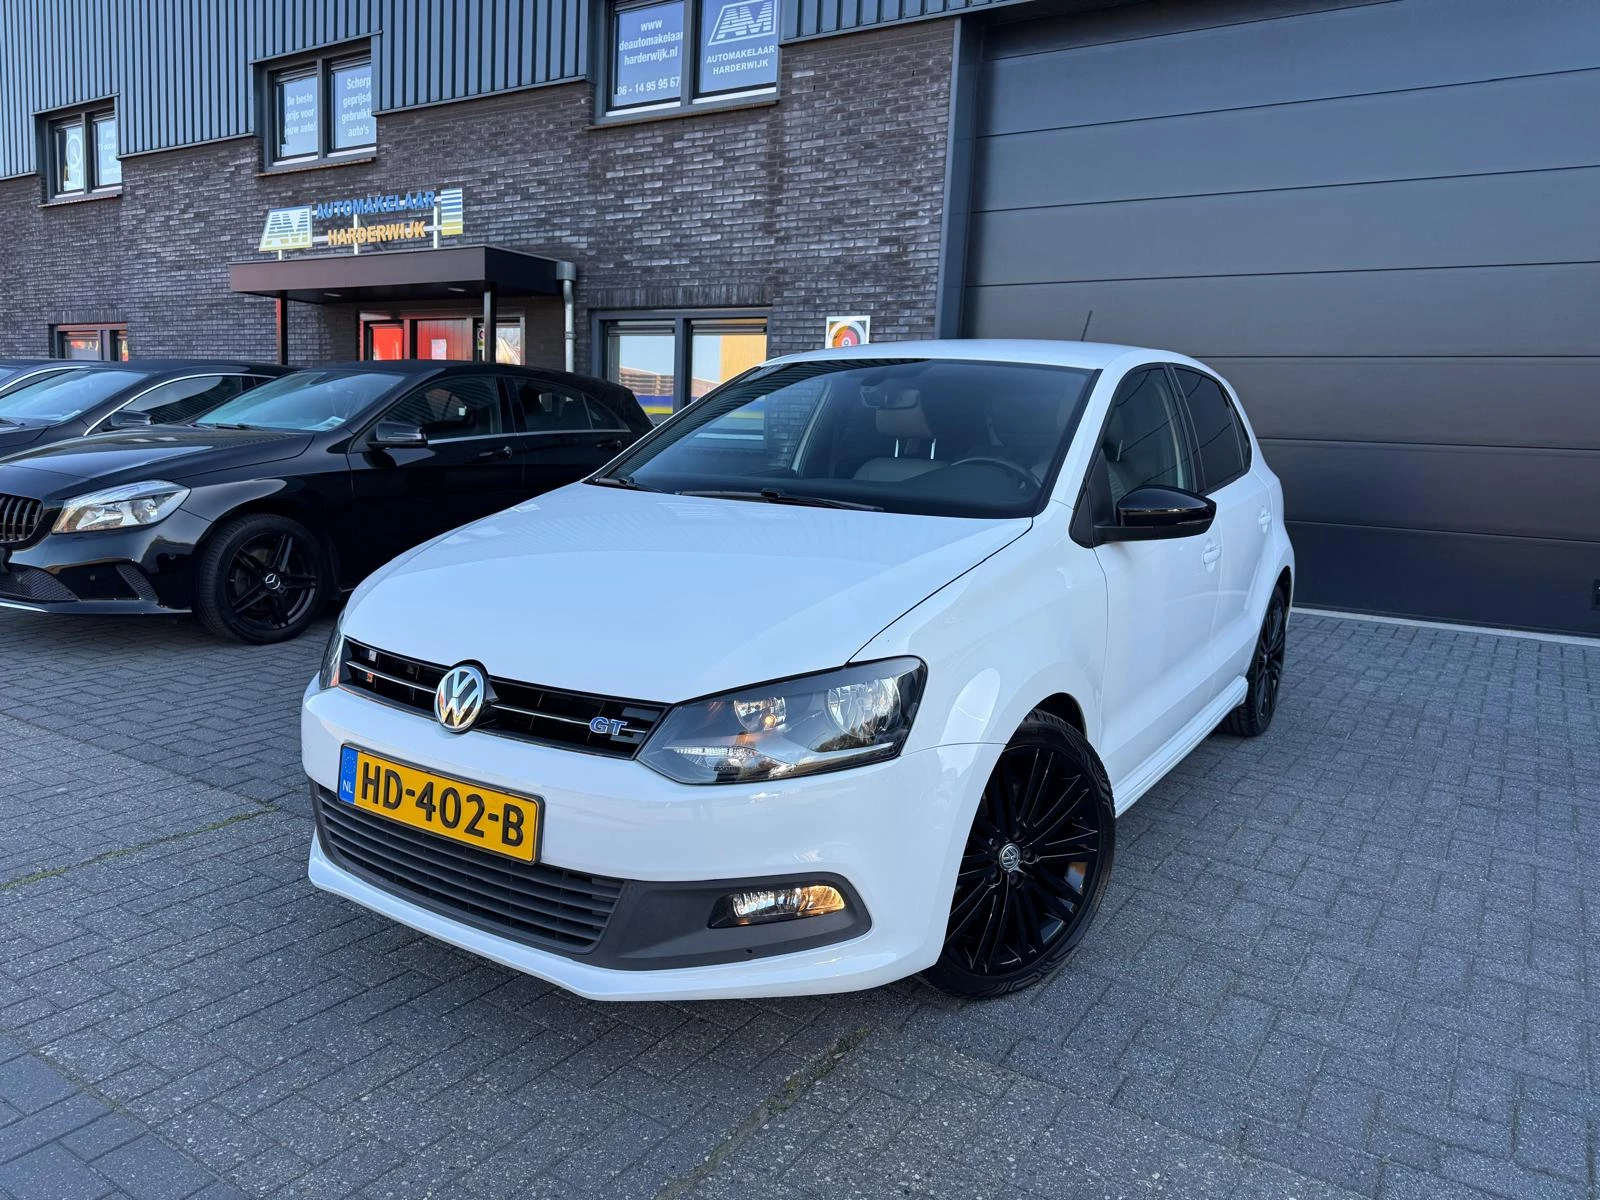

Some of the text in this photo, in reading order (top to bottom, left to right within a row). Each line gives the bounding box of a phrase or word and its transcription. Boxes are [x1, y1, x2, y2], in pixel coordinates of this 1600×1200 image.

[640, 19, 663, 32] www
[624, 46, 678, 66] harderwijk.nl
[706, 45, 775, 64] AUTOMAKELAAR
[712, 59, 769, 75] HARDERWIJK
[346, 76, 371, 90] Scherp
[617, 85, 628, 96] 06
[635, 82, 644, 93] 14
[646, 80, 656, 91] 95
[657, 78, 668, 90] 95
[670, 76, 681, 88] 67
[342, 91, 371, 109] geprijsd
[341, 108, 372, 125] gebruikt
[347, 124, 370, 137] auto's
[315, 190, 436, 220] AUTOMAKELAAR
[327, 221, 426, 246] HARDERWIJK
[588, 715, 628, 736] GT
[342, 780, 354, 794] NL
[360, 761, 524, 847] HD-402-B
